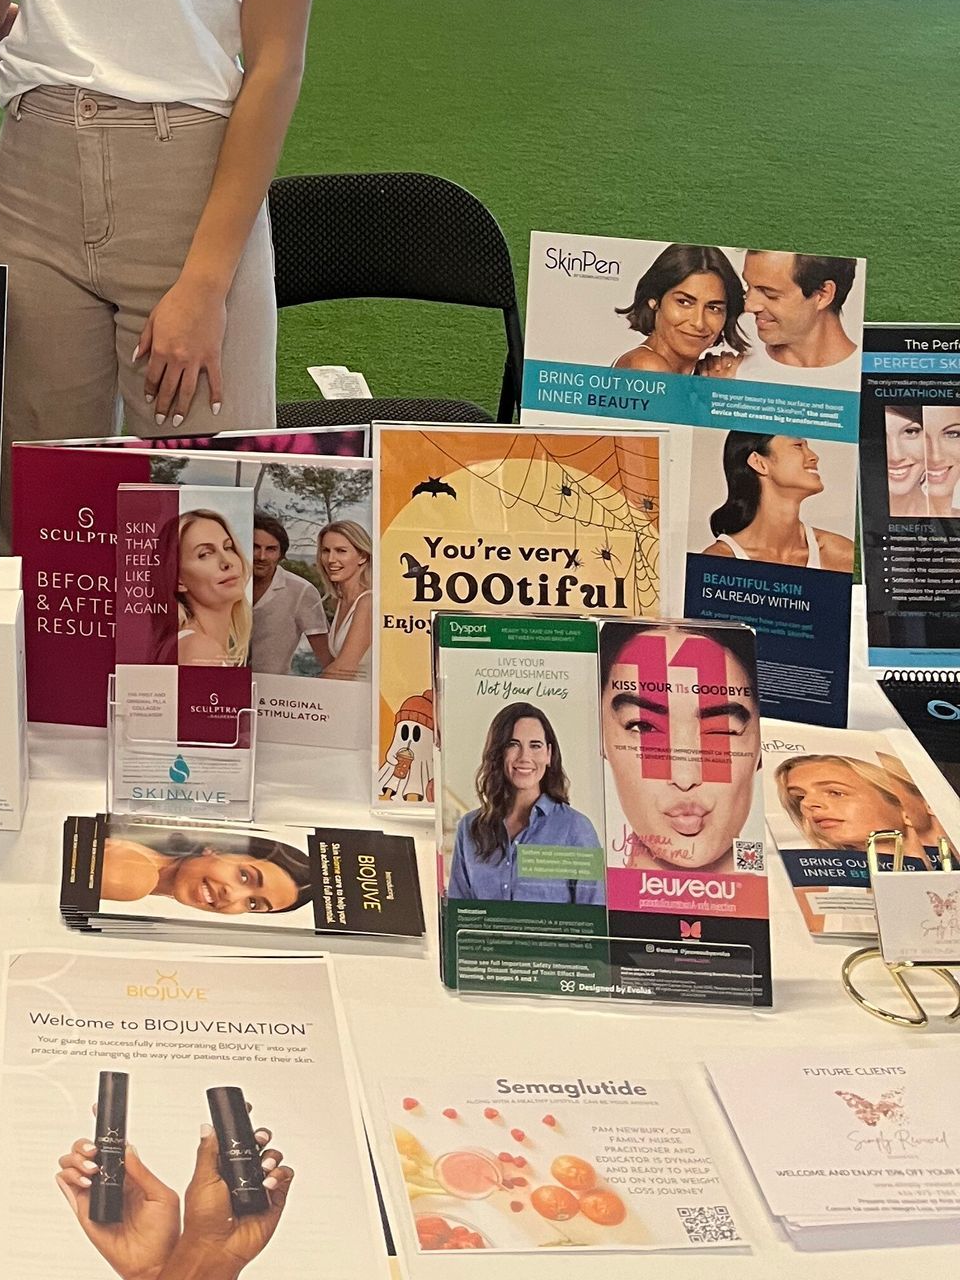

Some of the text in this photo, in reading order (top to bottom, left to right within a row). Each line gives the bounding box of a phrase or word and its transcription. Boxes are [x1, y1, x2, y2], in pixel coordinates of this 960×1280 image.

[545, 247, 620, 277] SkinPen
[904, 339, 929, 350] The
[873, 357, 935, 369] PERFECT
[539, 370, 666, 395] BRING OUT YOUR
[538, 389, 650, 411] INNER BEAUTY
[874, 387, 954, 398] GLUTATHIONE
[40, 527, 118, 545] SCULPTR
[125, 522, 156, 534] SKIN
[125, 538, 160, 550] THAT
[125, 554, 160, 566] FEELS
[518, 547, 580, 569] very
[125, 570, 151, 582] LIKE
[703, 573, 802, 595] BEAUTIFUL SKIN
[124, 586, 155, 598] YOU
[412, 571, 628, 609] BOOtiful
[36, 594, 114, 616] & AFTE
[702, 587, 811, 612] IS ALREADY WITHIN
[124, 603, 168, 614] AGAIN
[37, 617, 118, 638] RESULT
[449, 621, 487, 635] Dysport
[497, 657, 545, 667] LIVE YOUR
[474, 668, 569, 680] ACCOMPLISHMENTS
[476, 680, 569, 700] Not Your Lines
[611, 680, 637, 691] KISS
[639, 681, 673, 693] YOUR
[691, 684, 751, 697] GOODBYE
[190, 705, 238, 714] SCULPTRA
[259, 697, 324, 711] & ORIGINAL
[132, 786, 227, 804] SKINVIVE
[798, 857, 843, 867] BRING
[803, 869, 847, 878] INNER
[356, 855, 382, 912] BIOJUVE
[639, 872, 736, 899] Jeuveau
[126, 985, 207, 1001] BIOJUVE
[579, 983, 652, 994] Designed by Evolus
[29, 1011, 115, 1030] Welcome
[120, 1019, 139, 1031] to
[37, 1035, 59, 1044] Your
[60, 1036, 86, 1047] guide
[88, 1037, 98, 1045] to
[99, 1037, 154, 1050] successfully
[155, 1040, 216, 1052] incorporating
[266, 1043, 285, 1052] into
[286, 1045, 308, 1055] your
[803, 1066, 906, 1076] FUTURE CLIENTS
[496, 1078, 648, 1099] Semaglutide
